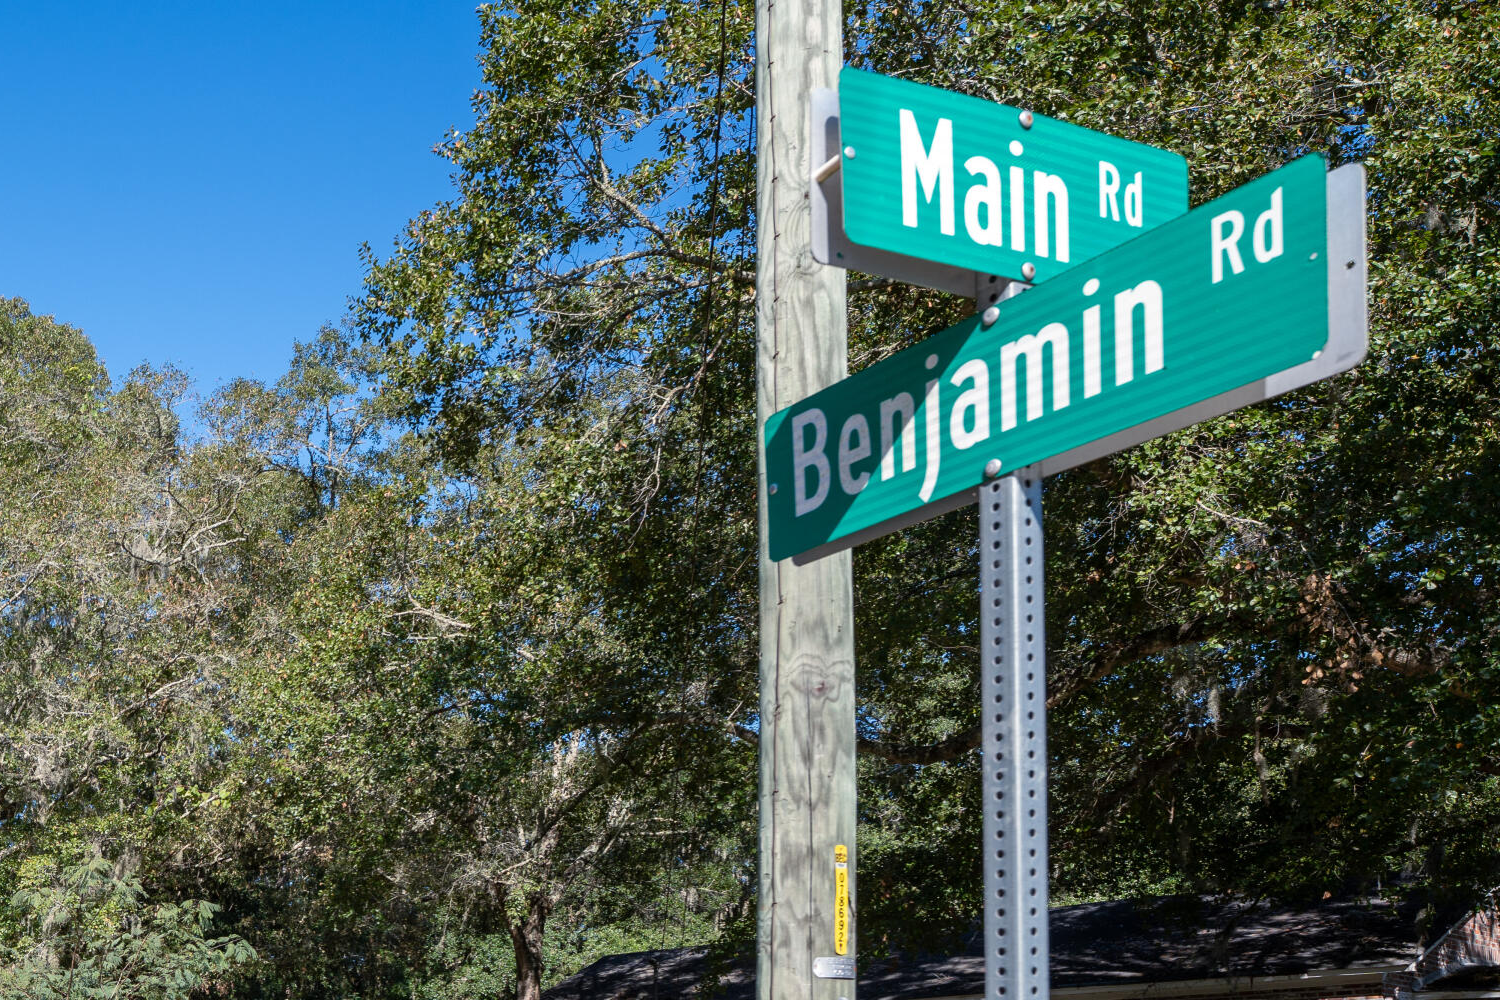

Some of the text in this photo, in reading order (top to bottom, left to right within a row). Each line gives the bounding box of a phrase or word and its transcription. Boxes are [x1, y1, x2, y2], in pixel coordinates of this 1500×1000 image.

[900, 108, 1144, 264] Main Rd
[791, 187, 1284, 518] Benjamin Rd
